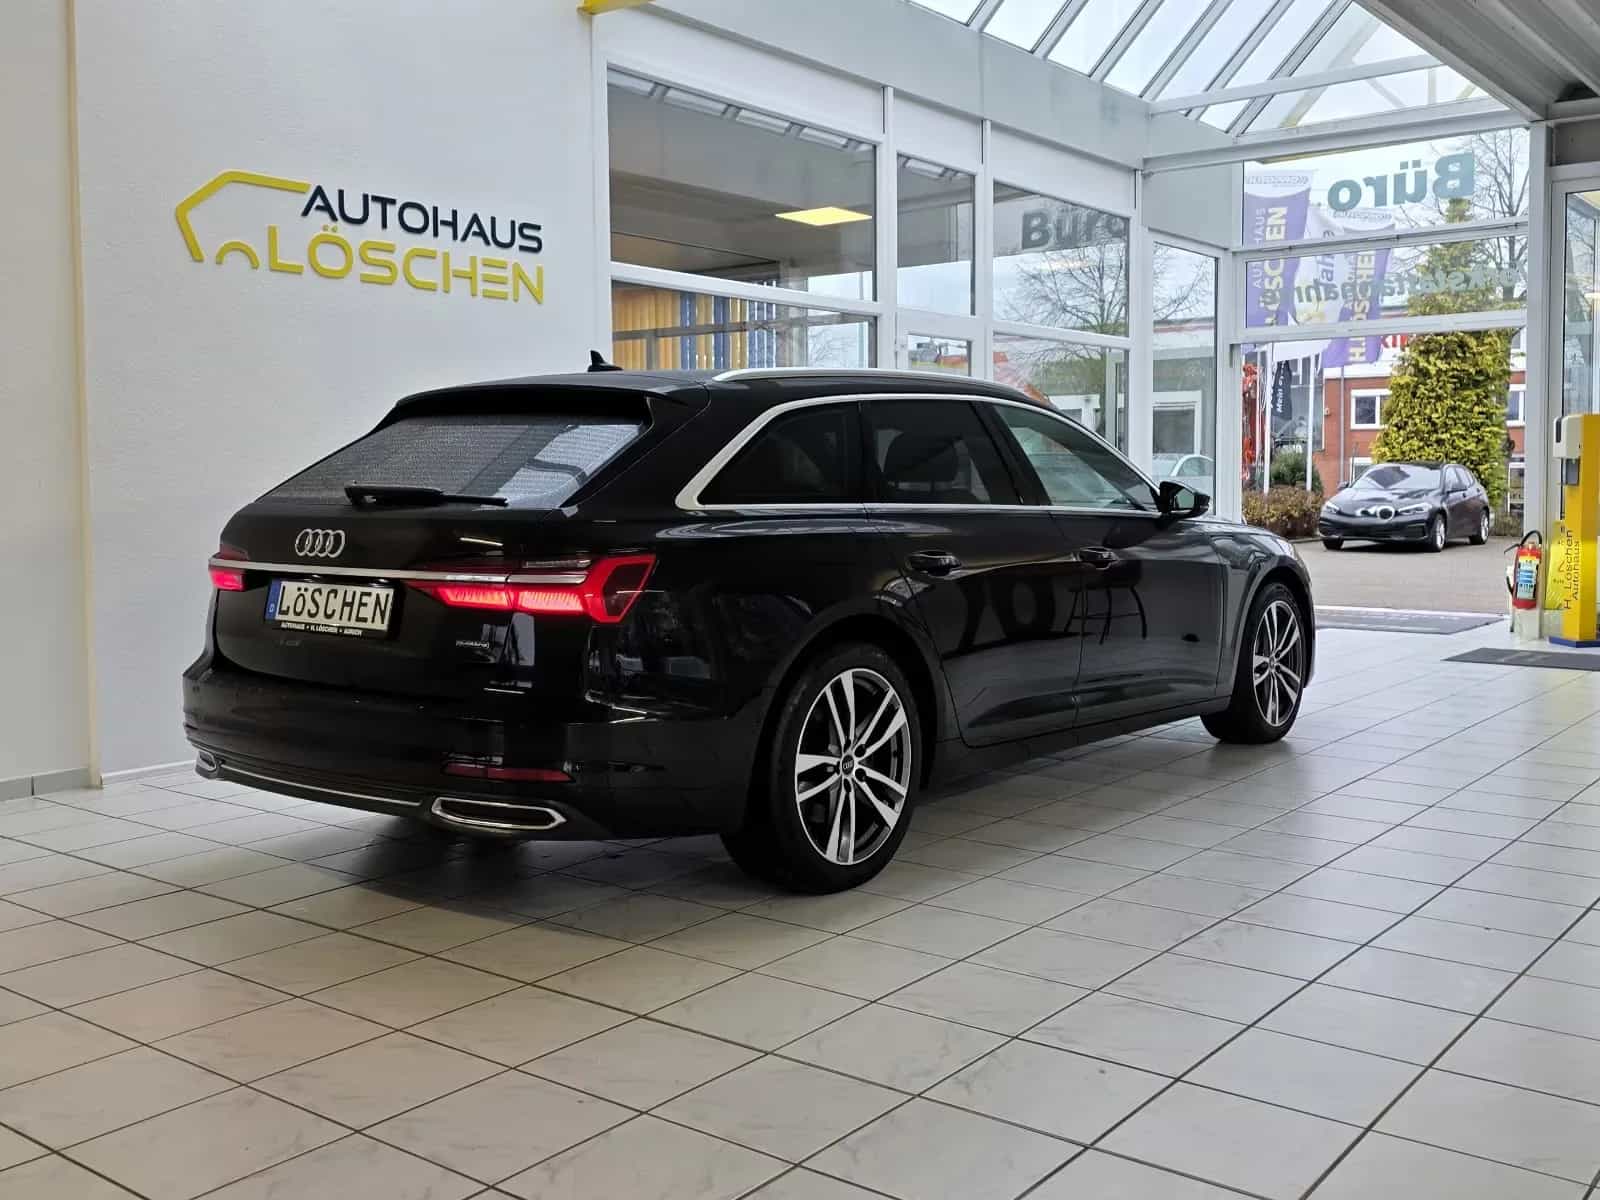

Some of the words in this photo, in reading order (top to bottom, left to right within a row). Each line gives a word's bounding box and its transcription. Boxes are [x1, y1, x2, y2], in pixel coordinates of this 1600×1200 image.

[301, 185, 543, 253] AUTOHAUS
[268, 224, 544, 304] LÖSCHEN
[278, 585, 390, 625] LÖSCHEN
